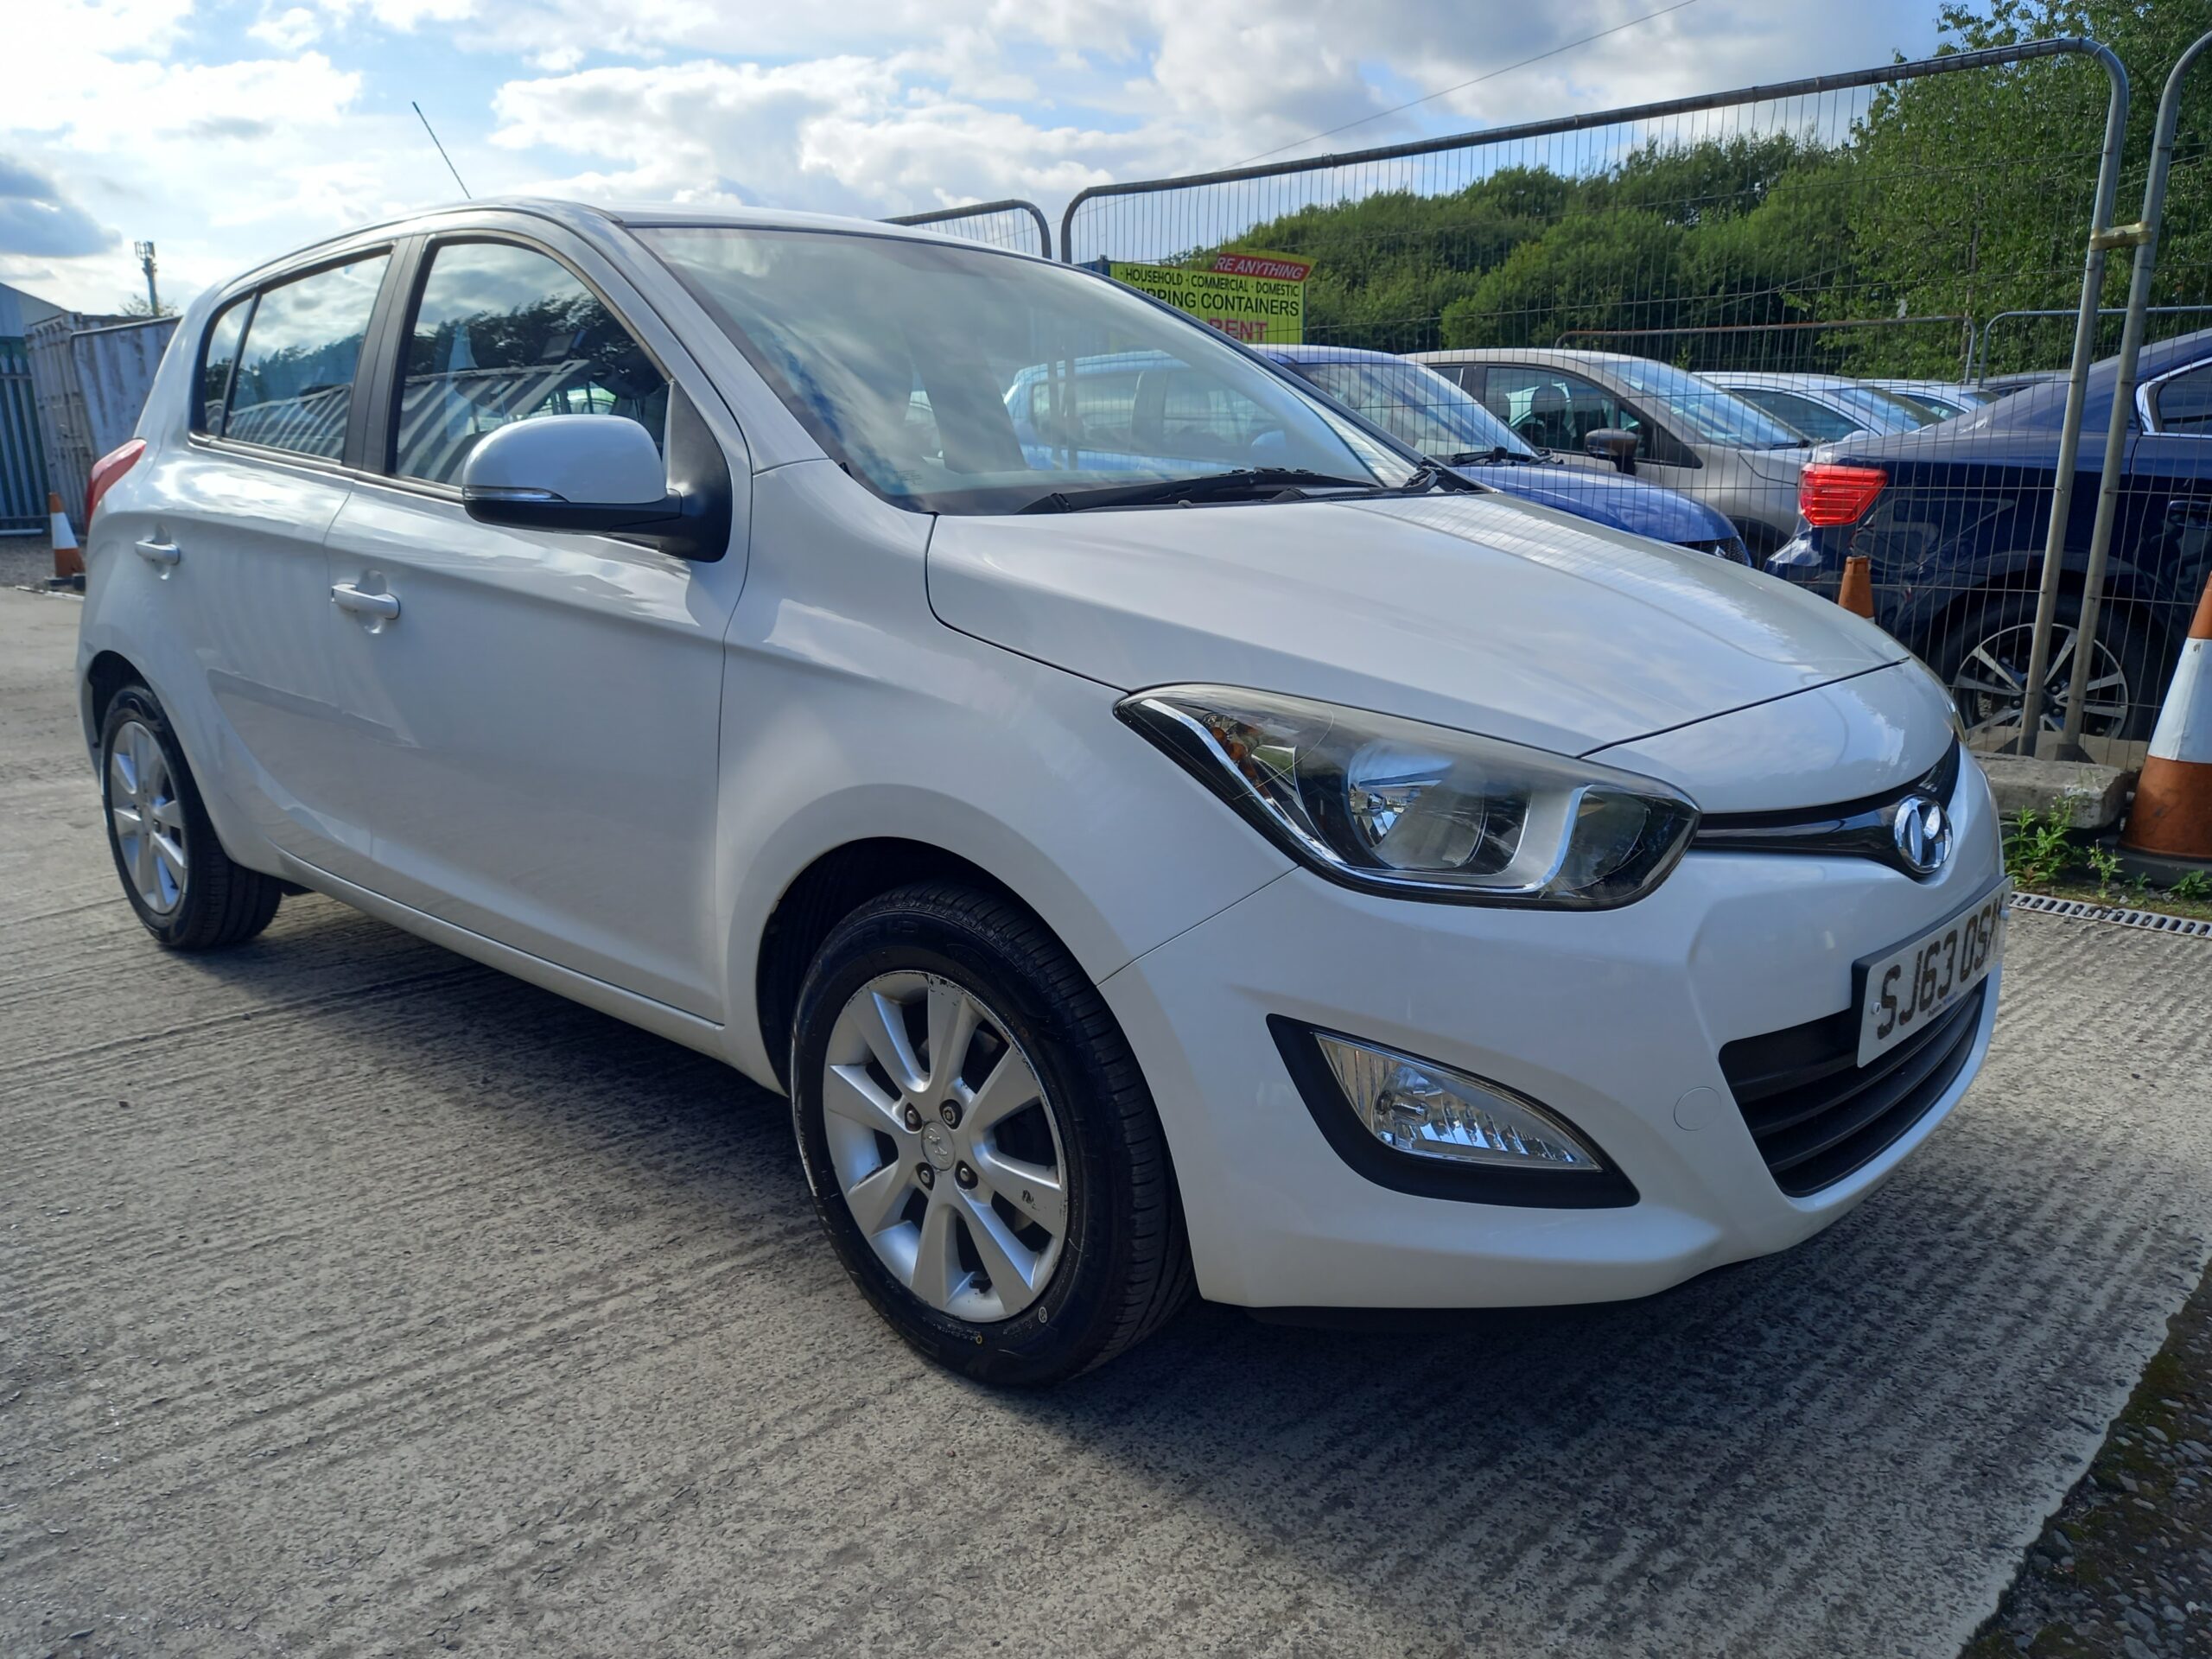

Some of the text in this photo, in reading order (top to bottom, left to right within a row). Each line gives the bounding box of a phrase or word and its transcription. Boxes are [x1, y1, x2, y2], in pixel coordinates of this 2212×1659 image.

[1125, 267, 1299, 297] HOUSEHOLD COMMERCIAL DOMESTIC
[1235, 260, 1305, 279] ANYTHING
[1137, 288, 1300, 317] PING CONTAINERS
[1877, 928, 1958, 1040] SJ63
